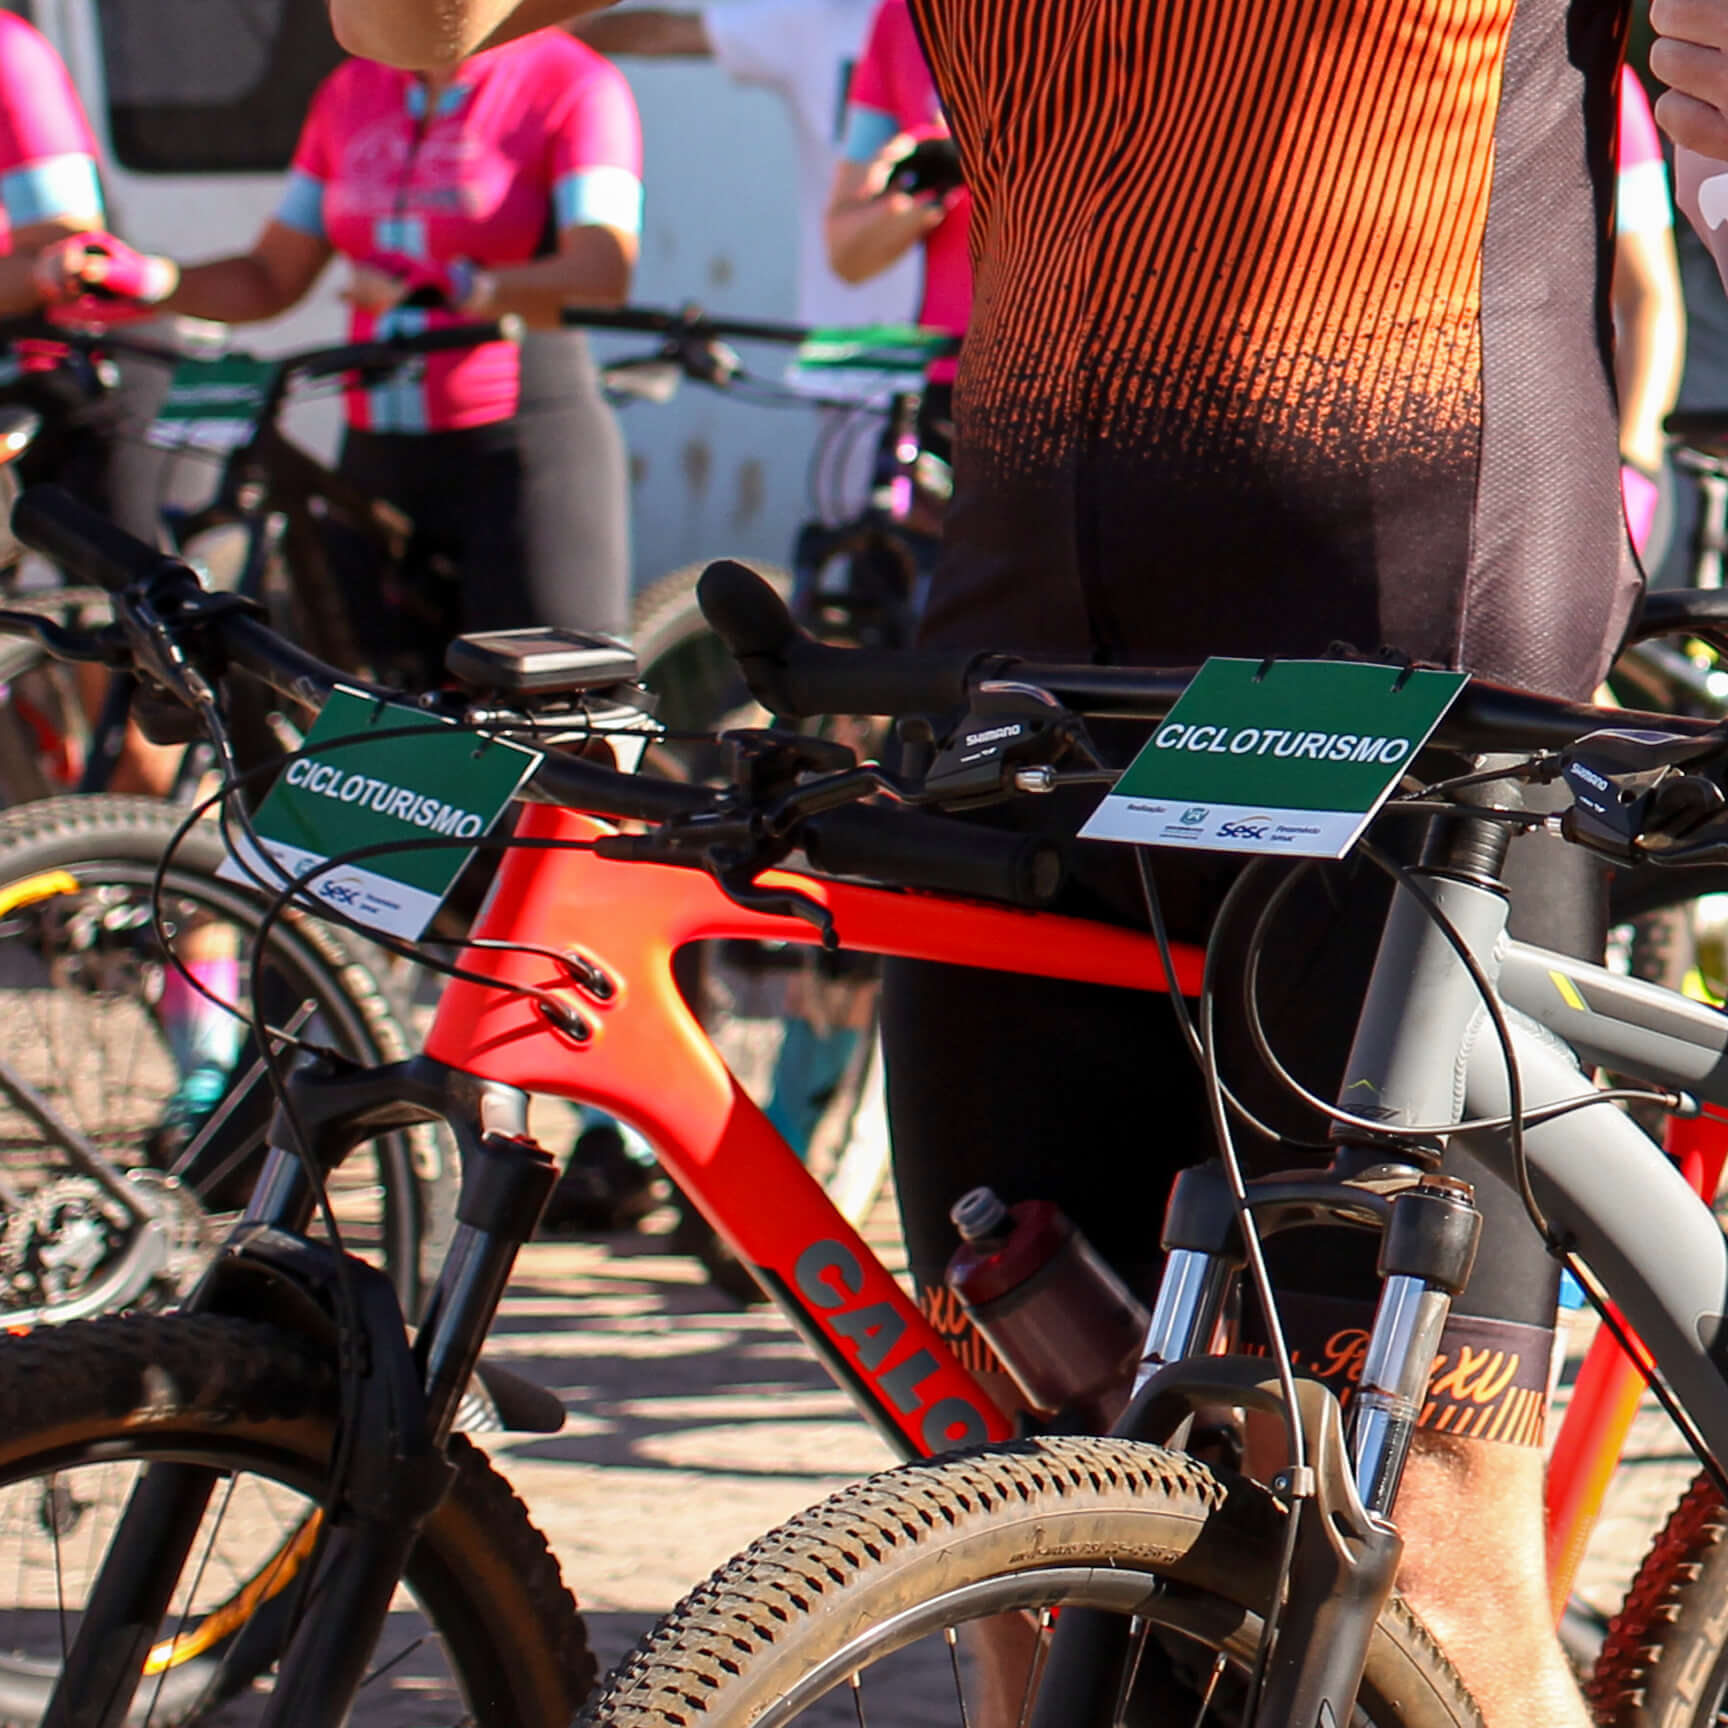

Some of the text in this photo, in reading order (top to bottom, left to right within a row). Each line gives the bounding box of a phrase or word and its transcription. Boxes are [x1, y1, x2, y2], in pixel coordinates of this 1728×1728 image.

[965, 723, 1021, 747] SHIMANO
[1155, 722, 1410, 764] CICLOTURISMO
[285, 758, 483, 839] CICLOTURISMO
[1216, 821, 1270, 840] Sesc
